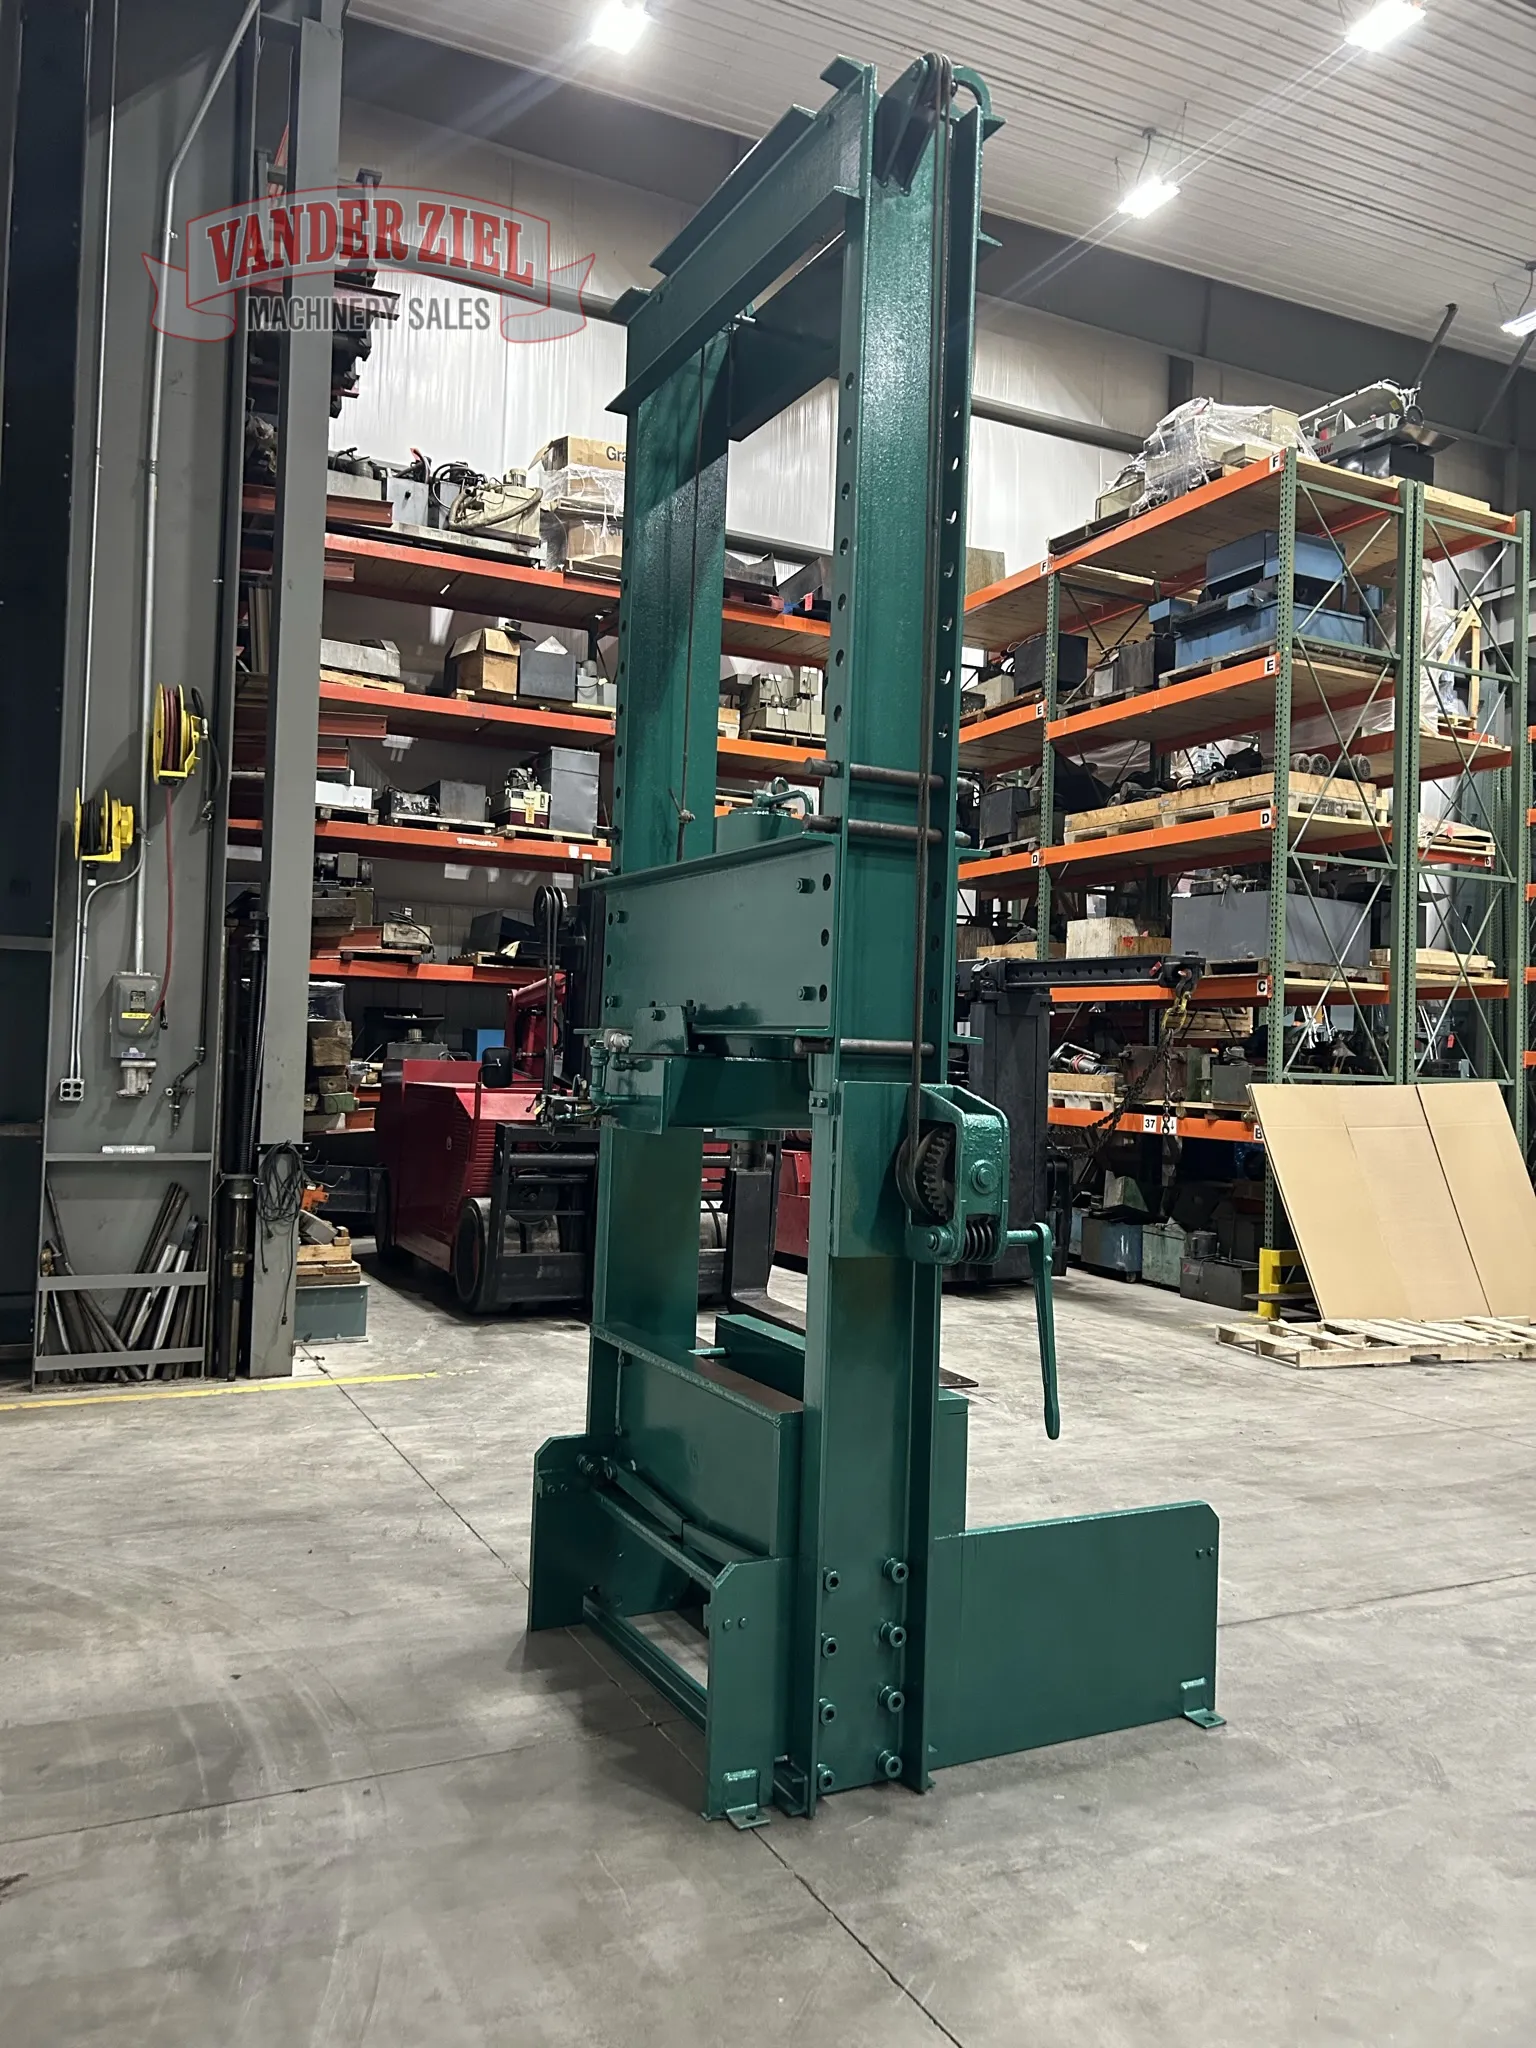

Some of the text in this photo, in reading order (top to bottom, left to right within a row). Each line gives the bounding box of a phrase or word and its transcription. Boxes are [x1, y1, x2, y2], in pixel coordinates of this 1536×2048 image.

[1272, 455, 1280, 468] F
[1041, 561, 1047, 572] F
[1266, 659, 1274, 671] E
[1037, 705, 1043, 715] E
[1261, 812, 1270, 825] D
[1032, 854, 1038, 864] D
[1257, 980, 1266, 992] C
[1144, 1118, 1156, 1129] 37
[1255, 1127, 1263, 1140] B
